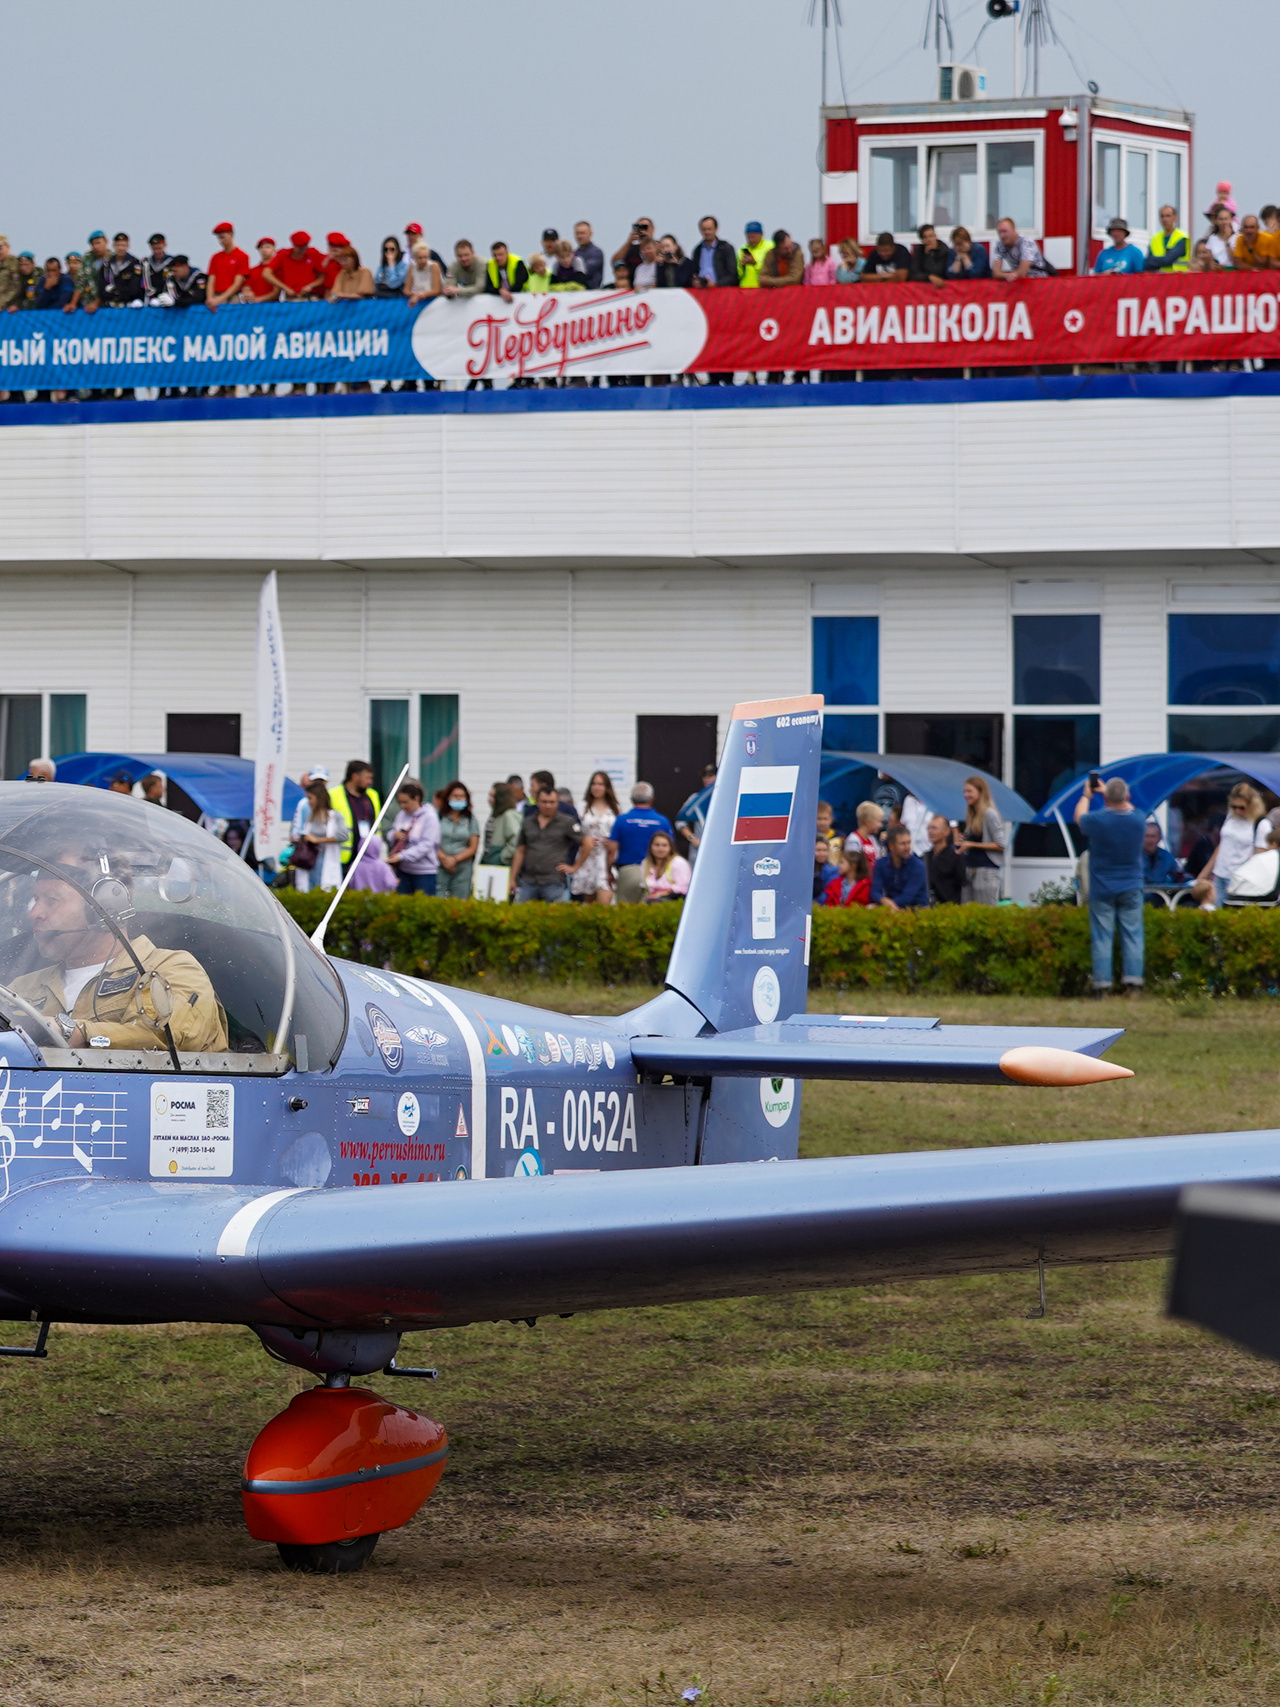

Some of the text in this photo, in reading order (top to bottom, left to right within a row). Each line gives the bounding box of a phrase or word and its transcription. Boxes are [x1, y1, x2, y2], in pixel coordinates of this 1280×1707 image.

[808, 301, 1033, 346] АВИАШКОЛА
[1116, 292, 1280, 337] ПАРАШЮ
[51, 336, 177, 366] КОМПЛЕКС
[182, 326, 267, 363] МАЛОЙ
[272, 328, 389, 363] АВИАЦИИ
[466, 297, 655, 377] Первушино
[776, 714, 819, 728] 602 economy
[170, 1101, 196, 1110] РОСМА
[765, 1101, 790, 1113] Kumpan
[340, 1135, 446, 1168] www.pervushino.ru
